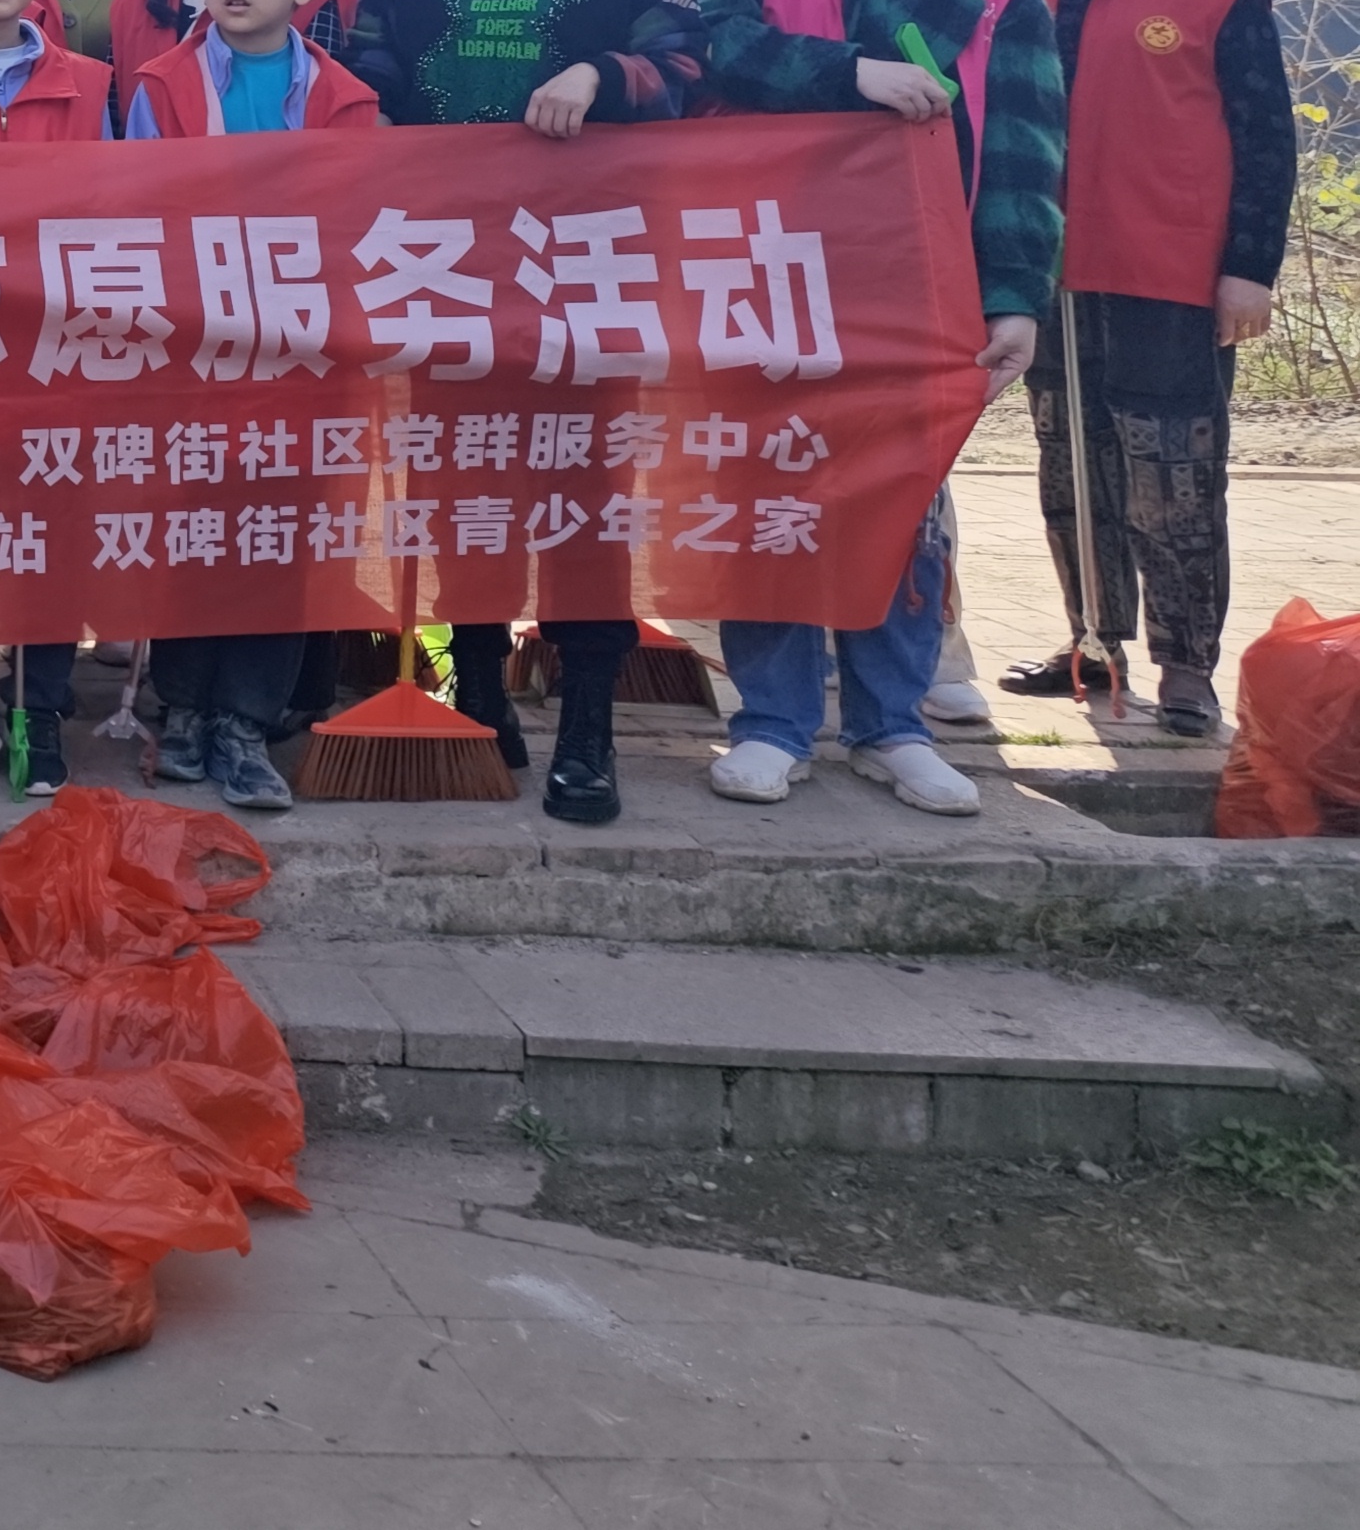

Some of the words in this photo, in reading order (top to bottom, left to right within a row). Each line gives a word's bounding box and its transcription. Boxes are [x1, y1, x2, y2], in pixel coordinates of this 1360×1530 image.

[19, 411, 829, 486] 双碑街社区党群服务中心
[92, 493, 822, 570] 双碑街社区青少年之家
